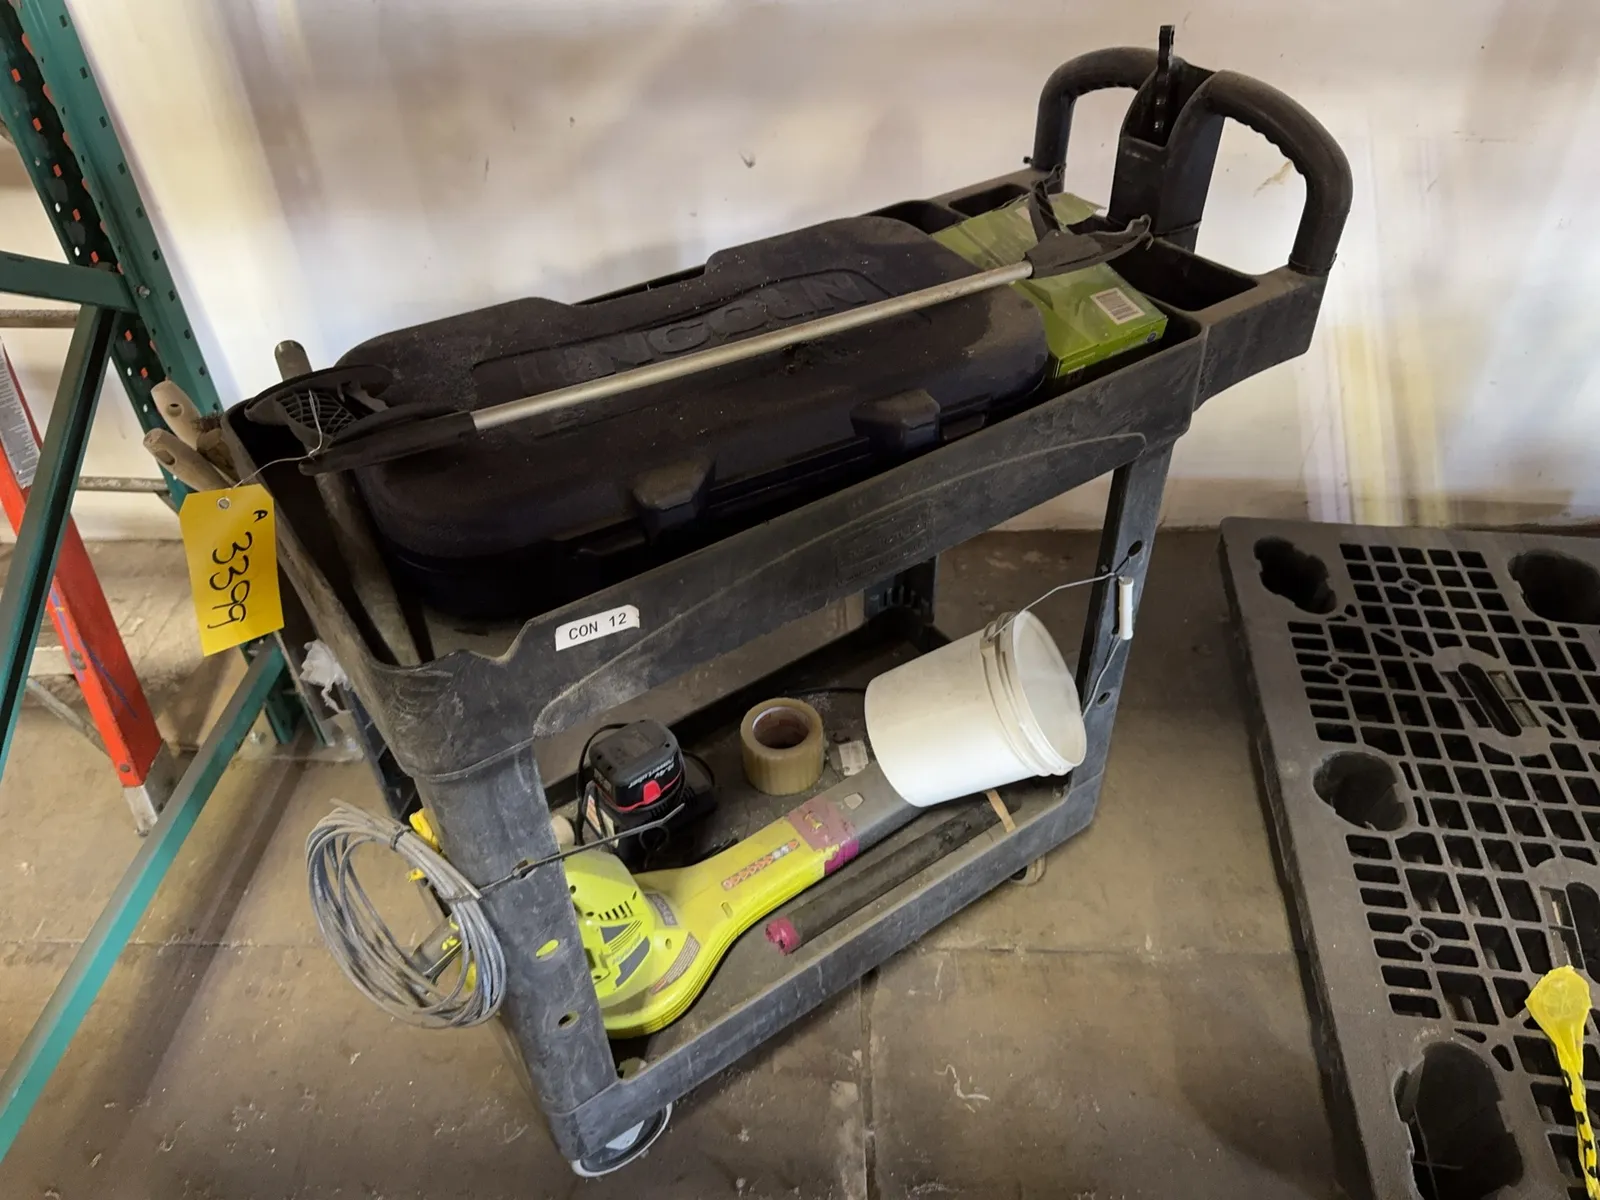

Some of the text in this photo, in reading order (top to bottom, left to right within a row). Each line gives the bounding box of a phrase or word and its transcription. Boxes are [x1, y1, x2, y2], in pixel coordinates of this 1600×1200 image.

[252, 509, 269, 523] A
[207, 531, 253, 630] 3399
[569, 612, 627, 640] CON 12
